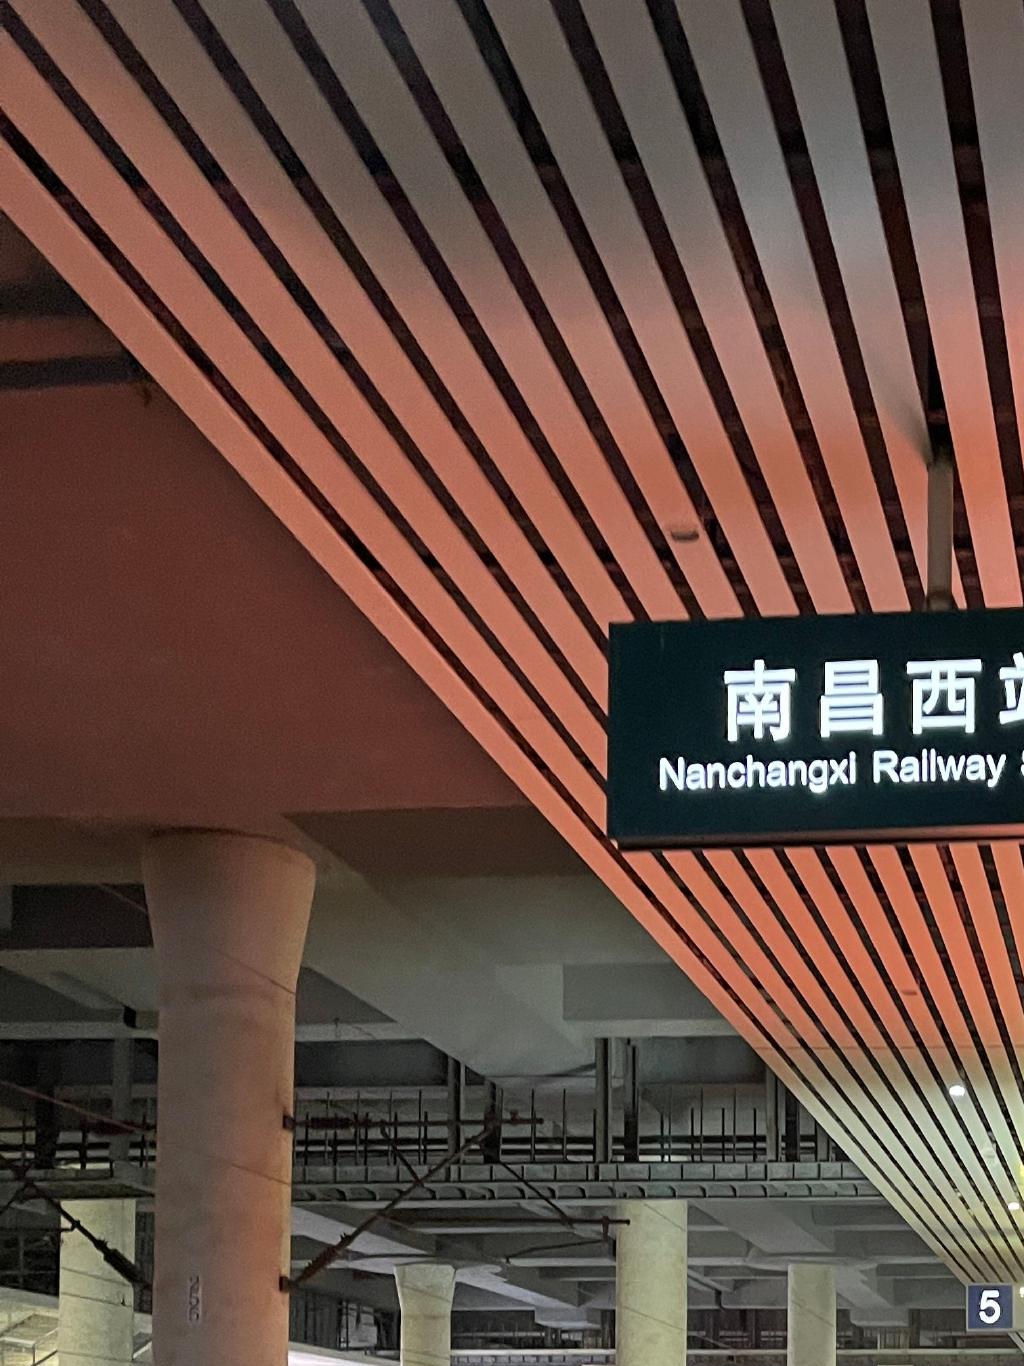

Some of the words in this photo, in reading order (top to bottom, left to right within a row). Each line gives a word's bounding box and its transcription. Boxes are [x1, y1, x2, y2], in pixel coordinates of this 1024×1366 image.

[659, 750, 857, 793] Nanchangxi
[872, 748, 1006, 787] Railway
[978, 1290, 1002, 1324] 5
